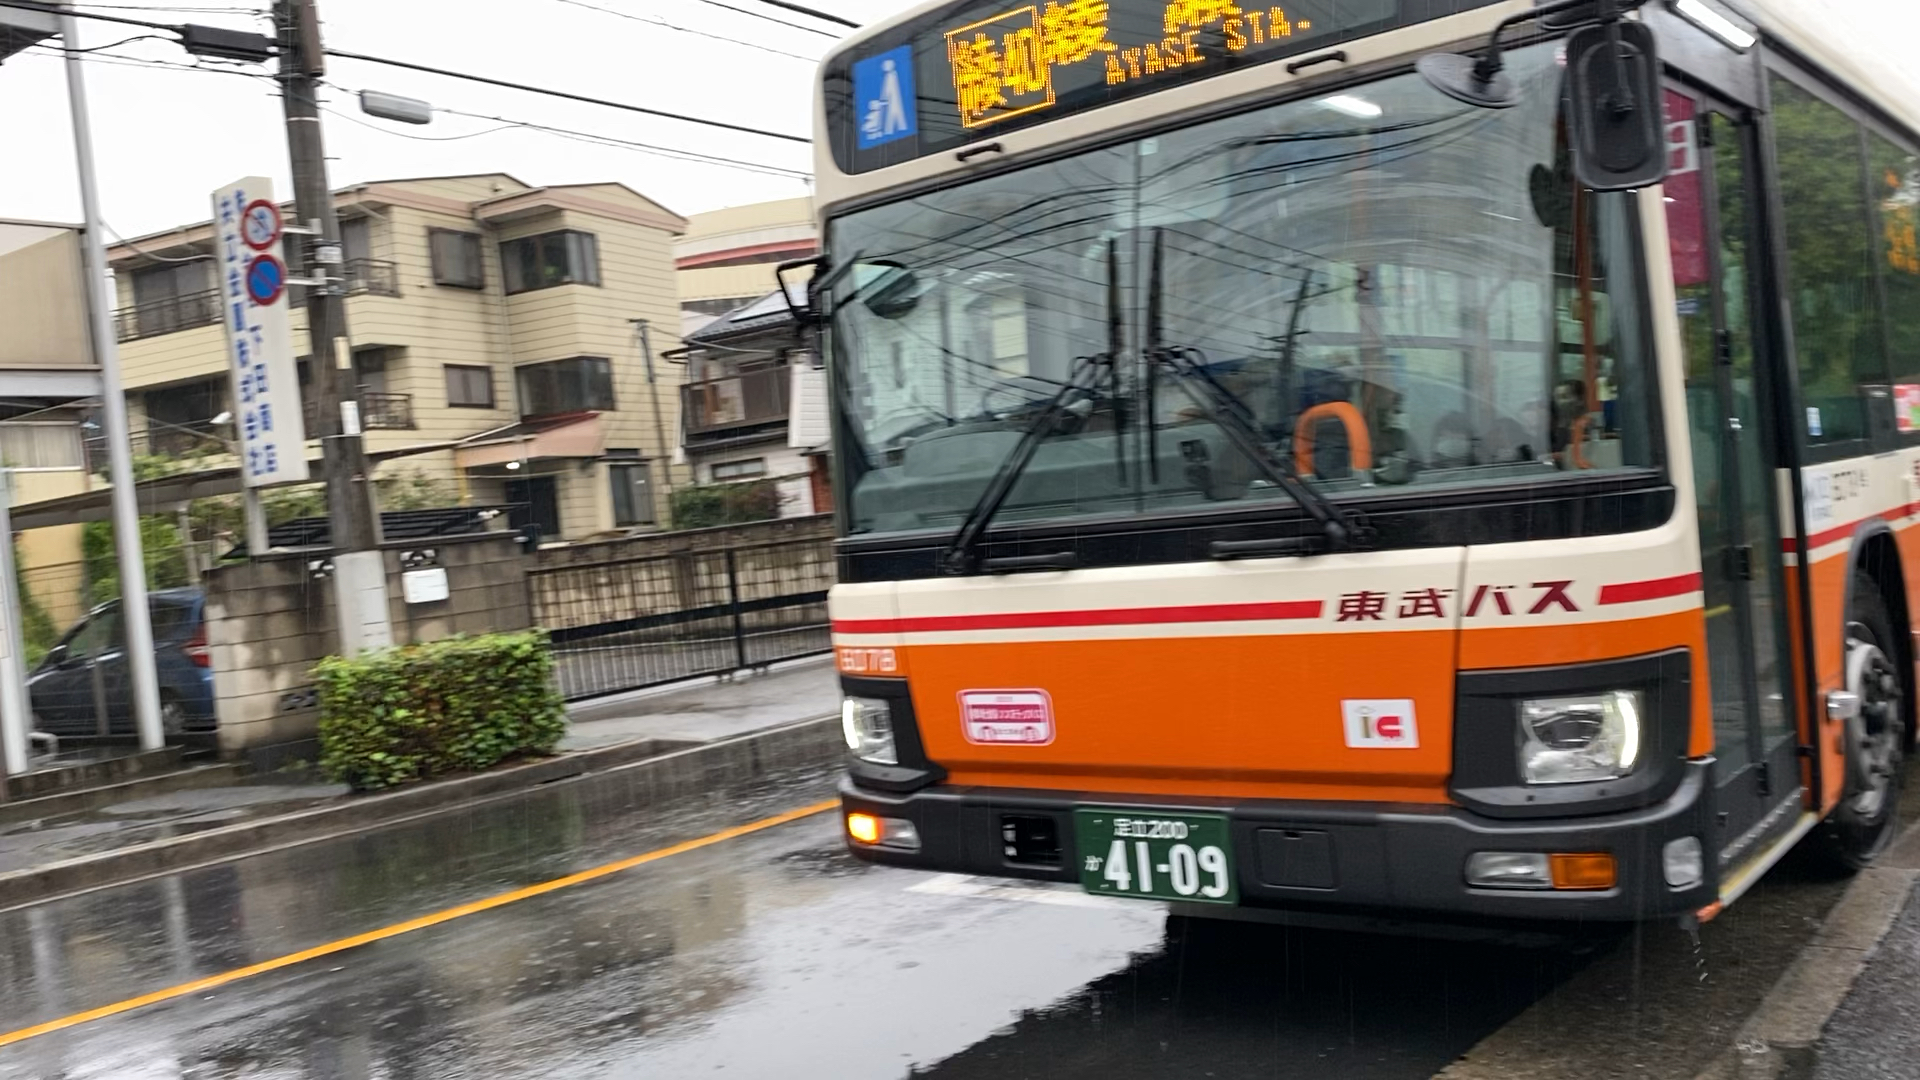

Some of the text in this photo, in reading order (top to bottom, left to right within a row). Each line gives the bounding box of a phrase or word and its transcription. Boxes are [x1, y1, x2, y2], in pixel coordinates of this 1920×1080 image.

[1105, 30, 1205, 85] AYASE
[1336, 580, 1581, 622] 東武バス
[1104, 839, 1230, 898] 41-09
